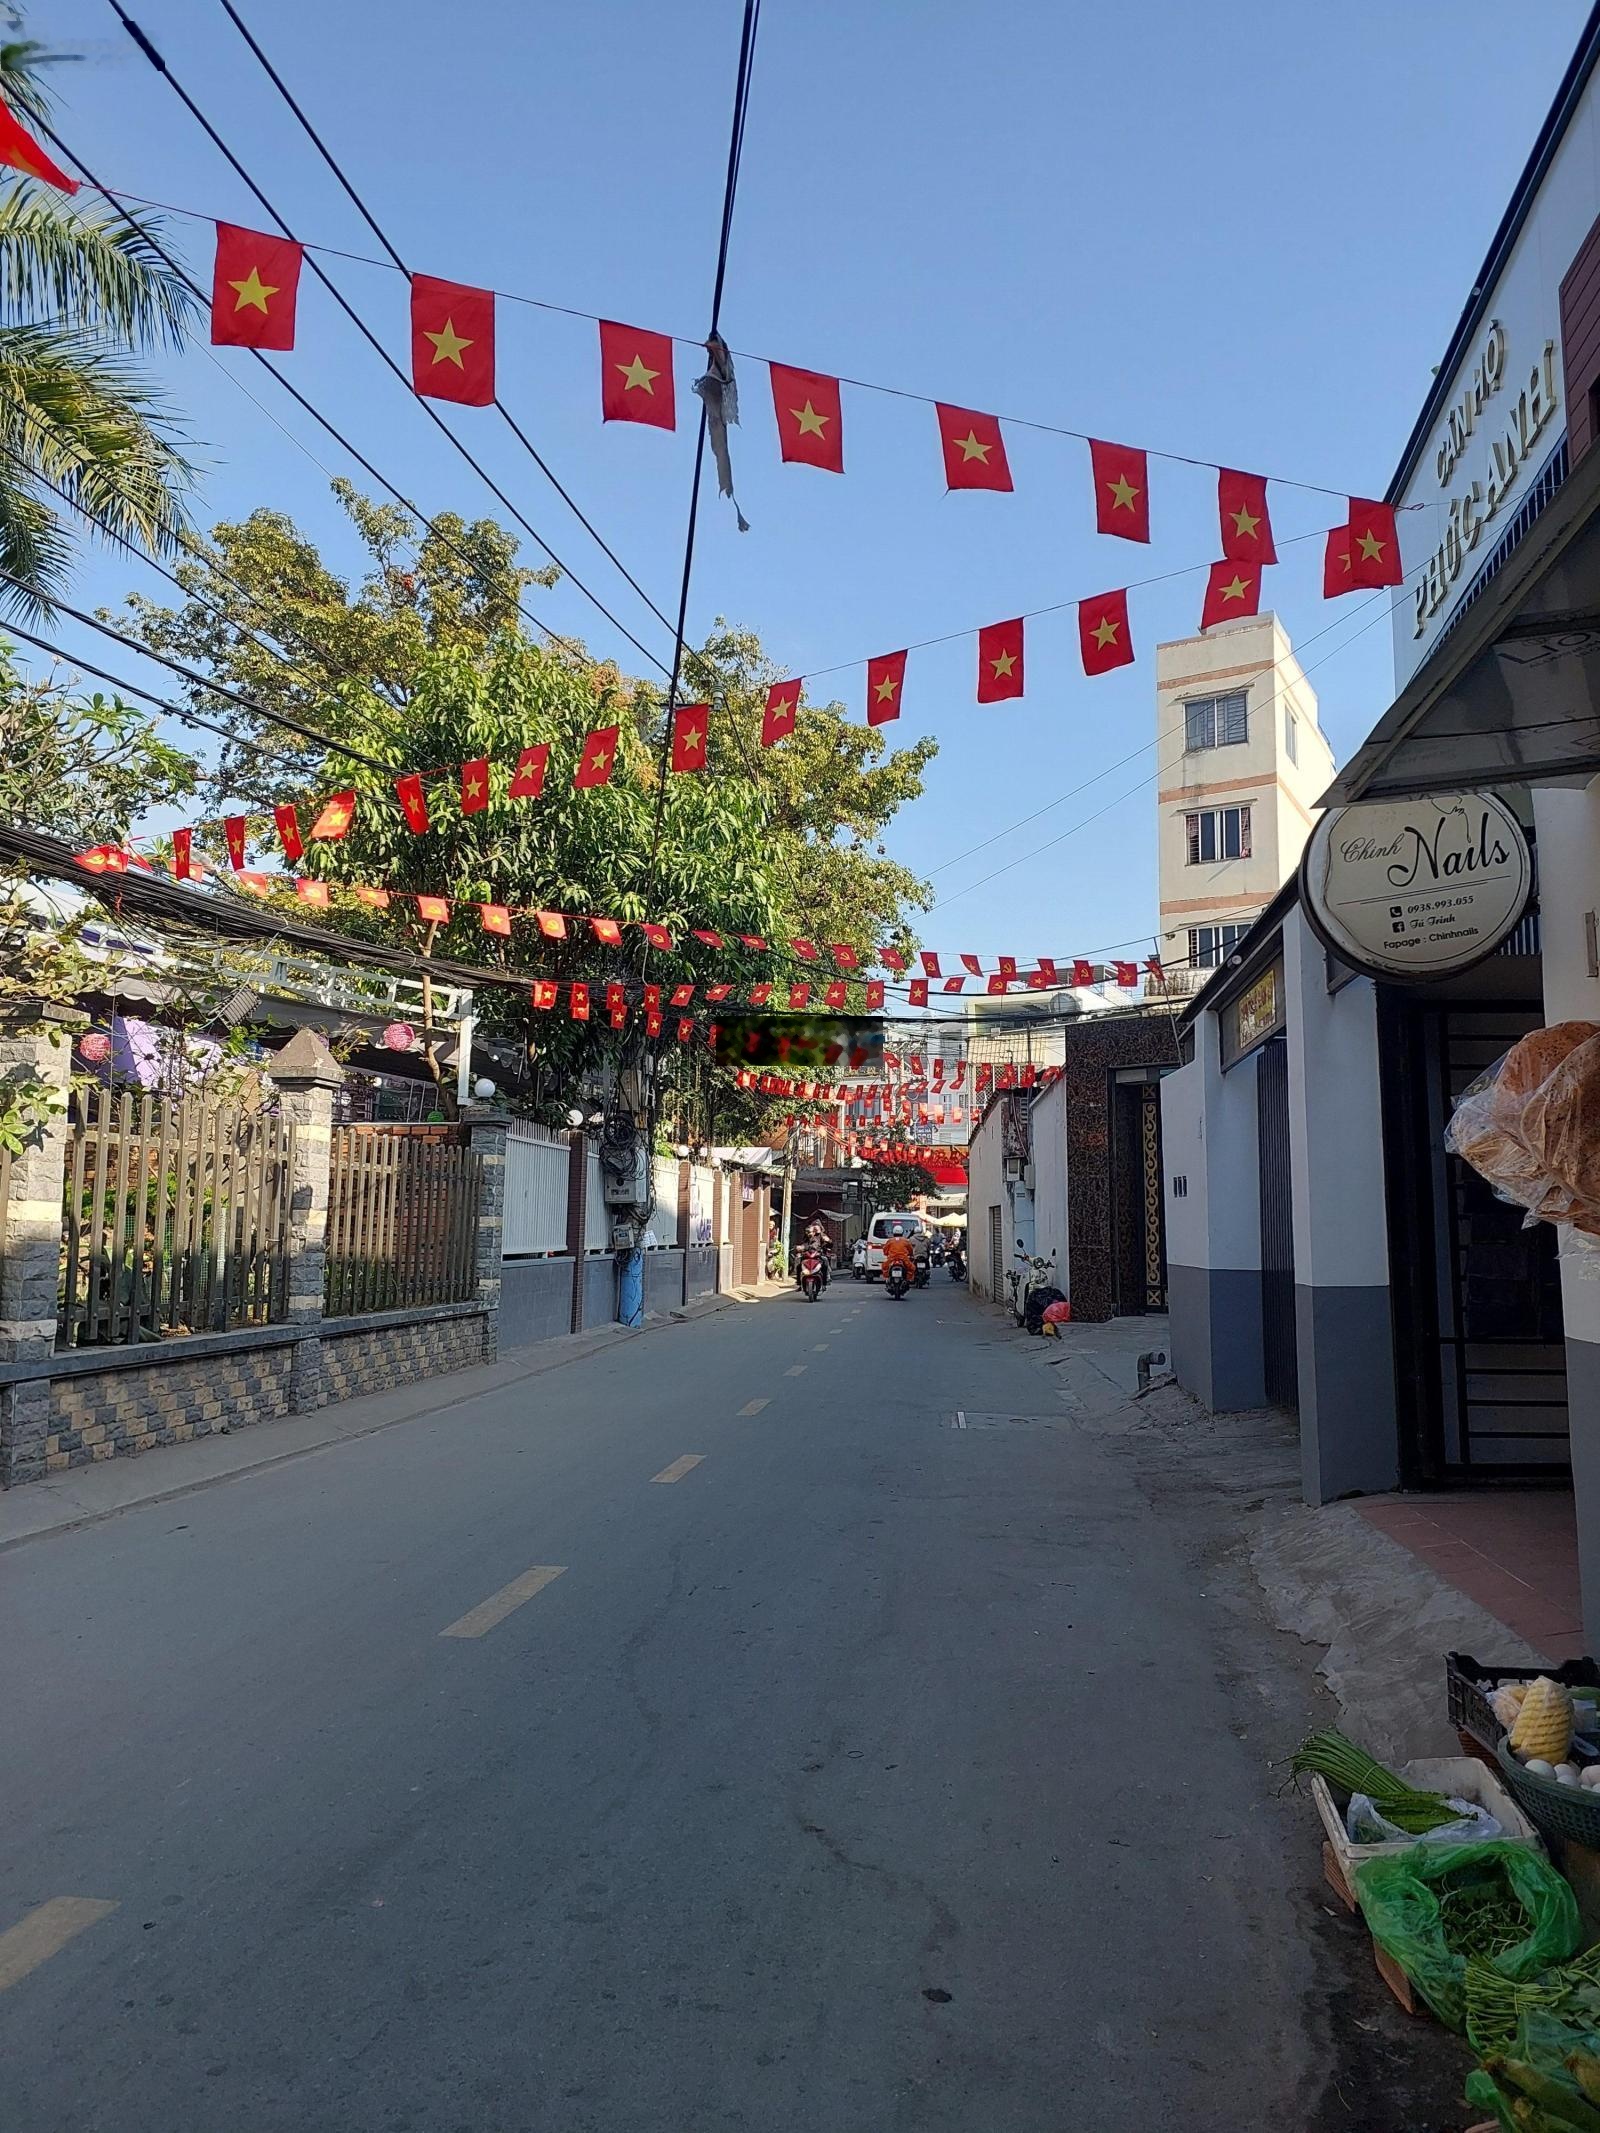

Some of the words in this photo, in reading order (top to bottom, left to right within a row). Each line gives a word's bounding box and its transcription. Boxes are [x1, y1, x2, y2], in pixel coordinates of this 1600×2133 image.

[1484, 338, 1557, 520] ANH
[1340, 832, 1405, 863] Chinh
[1387, 812, 1511, 887] Nails
[1407, 895, 1474, 914] 0938.993.055
[1383, 937, 1421, 950] Fapage
[1428, 927, 1479, 942] Chinhnails
